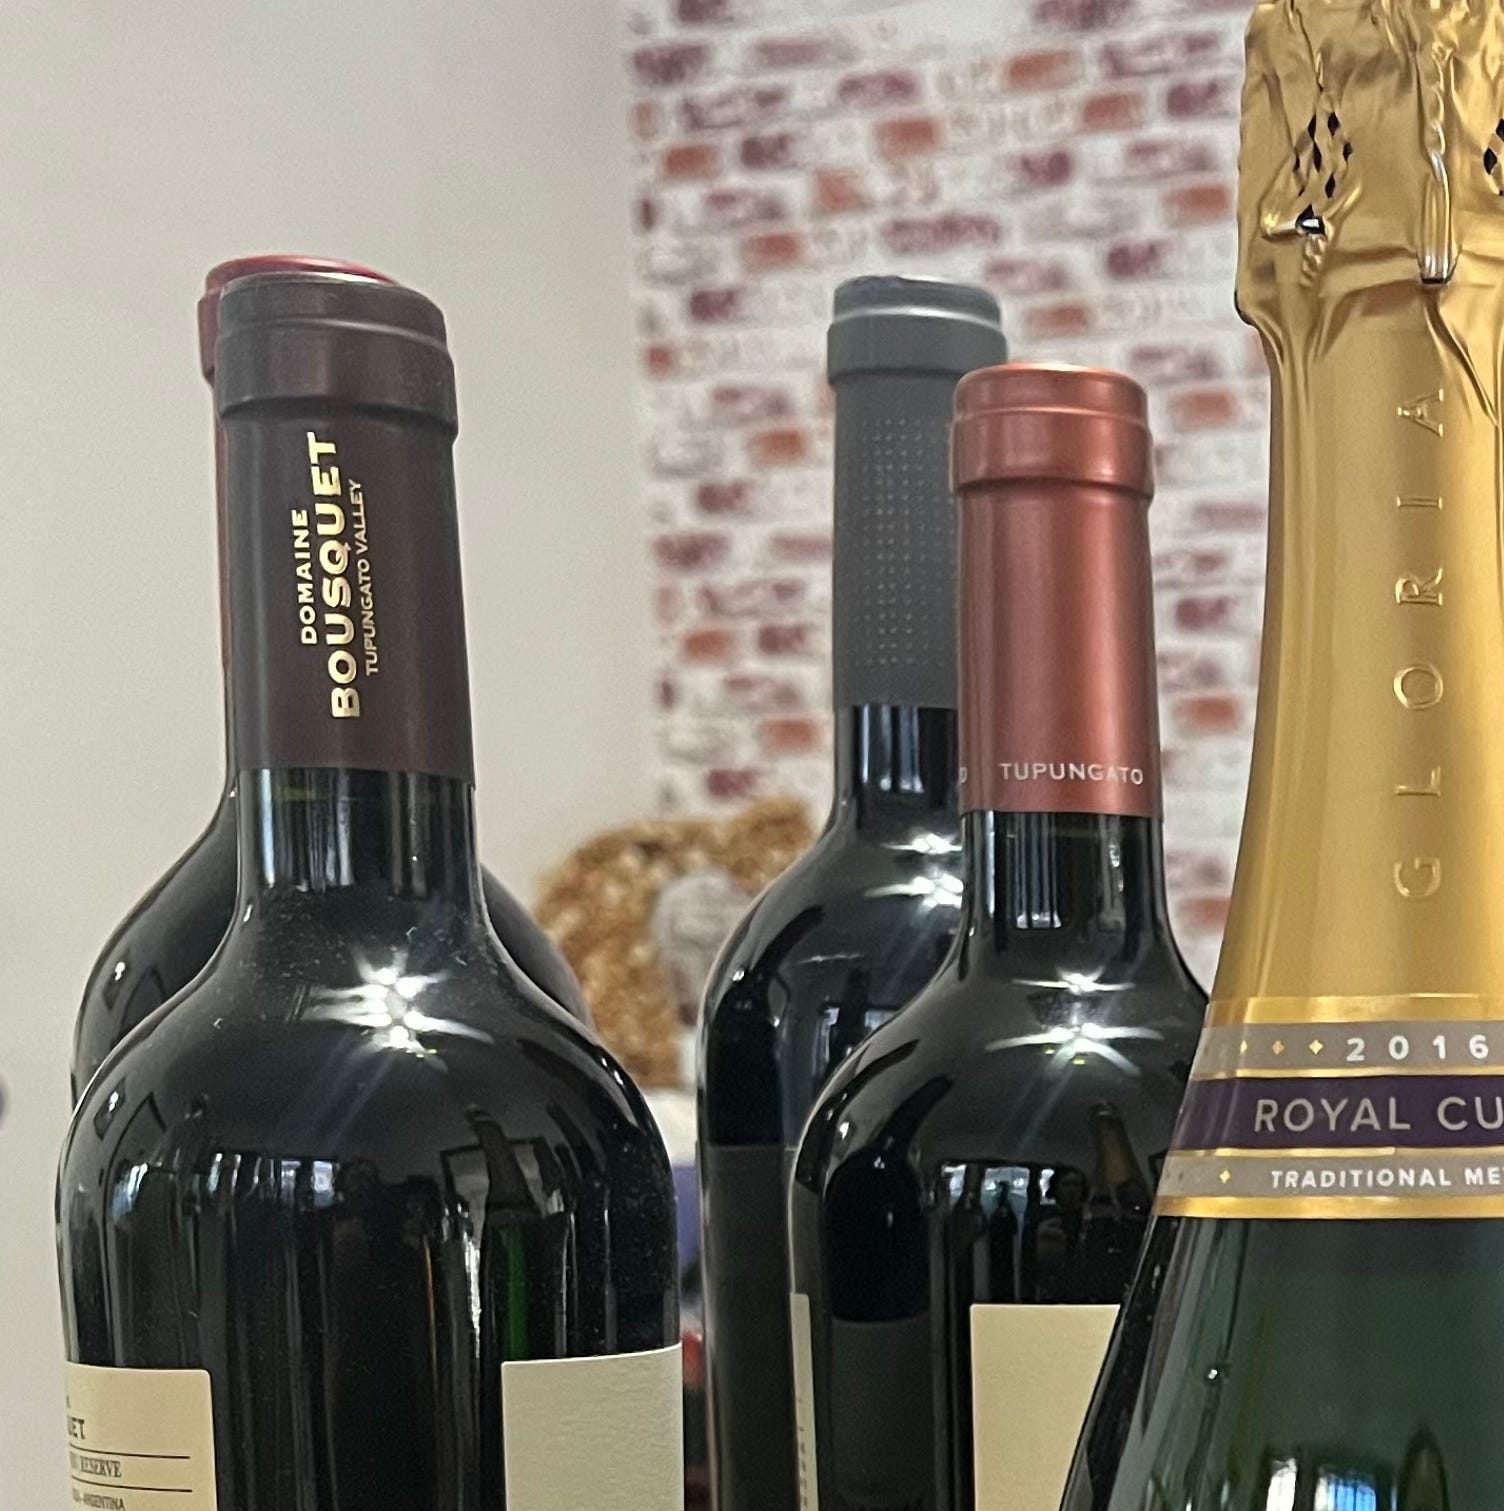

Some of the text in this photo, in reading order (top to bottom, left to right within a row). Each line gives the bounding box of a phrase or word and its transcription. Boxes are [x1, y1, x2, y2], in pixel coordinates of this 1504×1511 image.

[291, 509, 317, 645] DOMAINE
[306, 431, 360, 718] BOUSQUET
[348, 479, 379, 676] TUPUNGATO VALLEY
[1392, 389, 1444, 898] GLORIA
[1000, 761, 1144, 785] TUPUNGATO
[1347, 1034, 1490, 1062] 2016
[1254, 1097, 1411, 1133] ROYAL
[1271, 1167, 1452, 1189] TRADITIONAL
